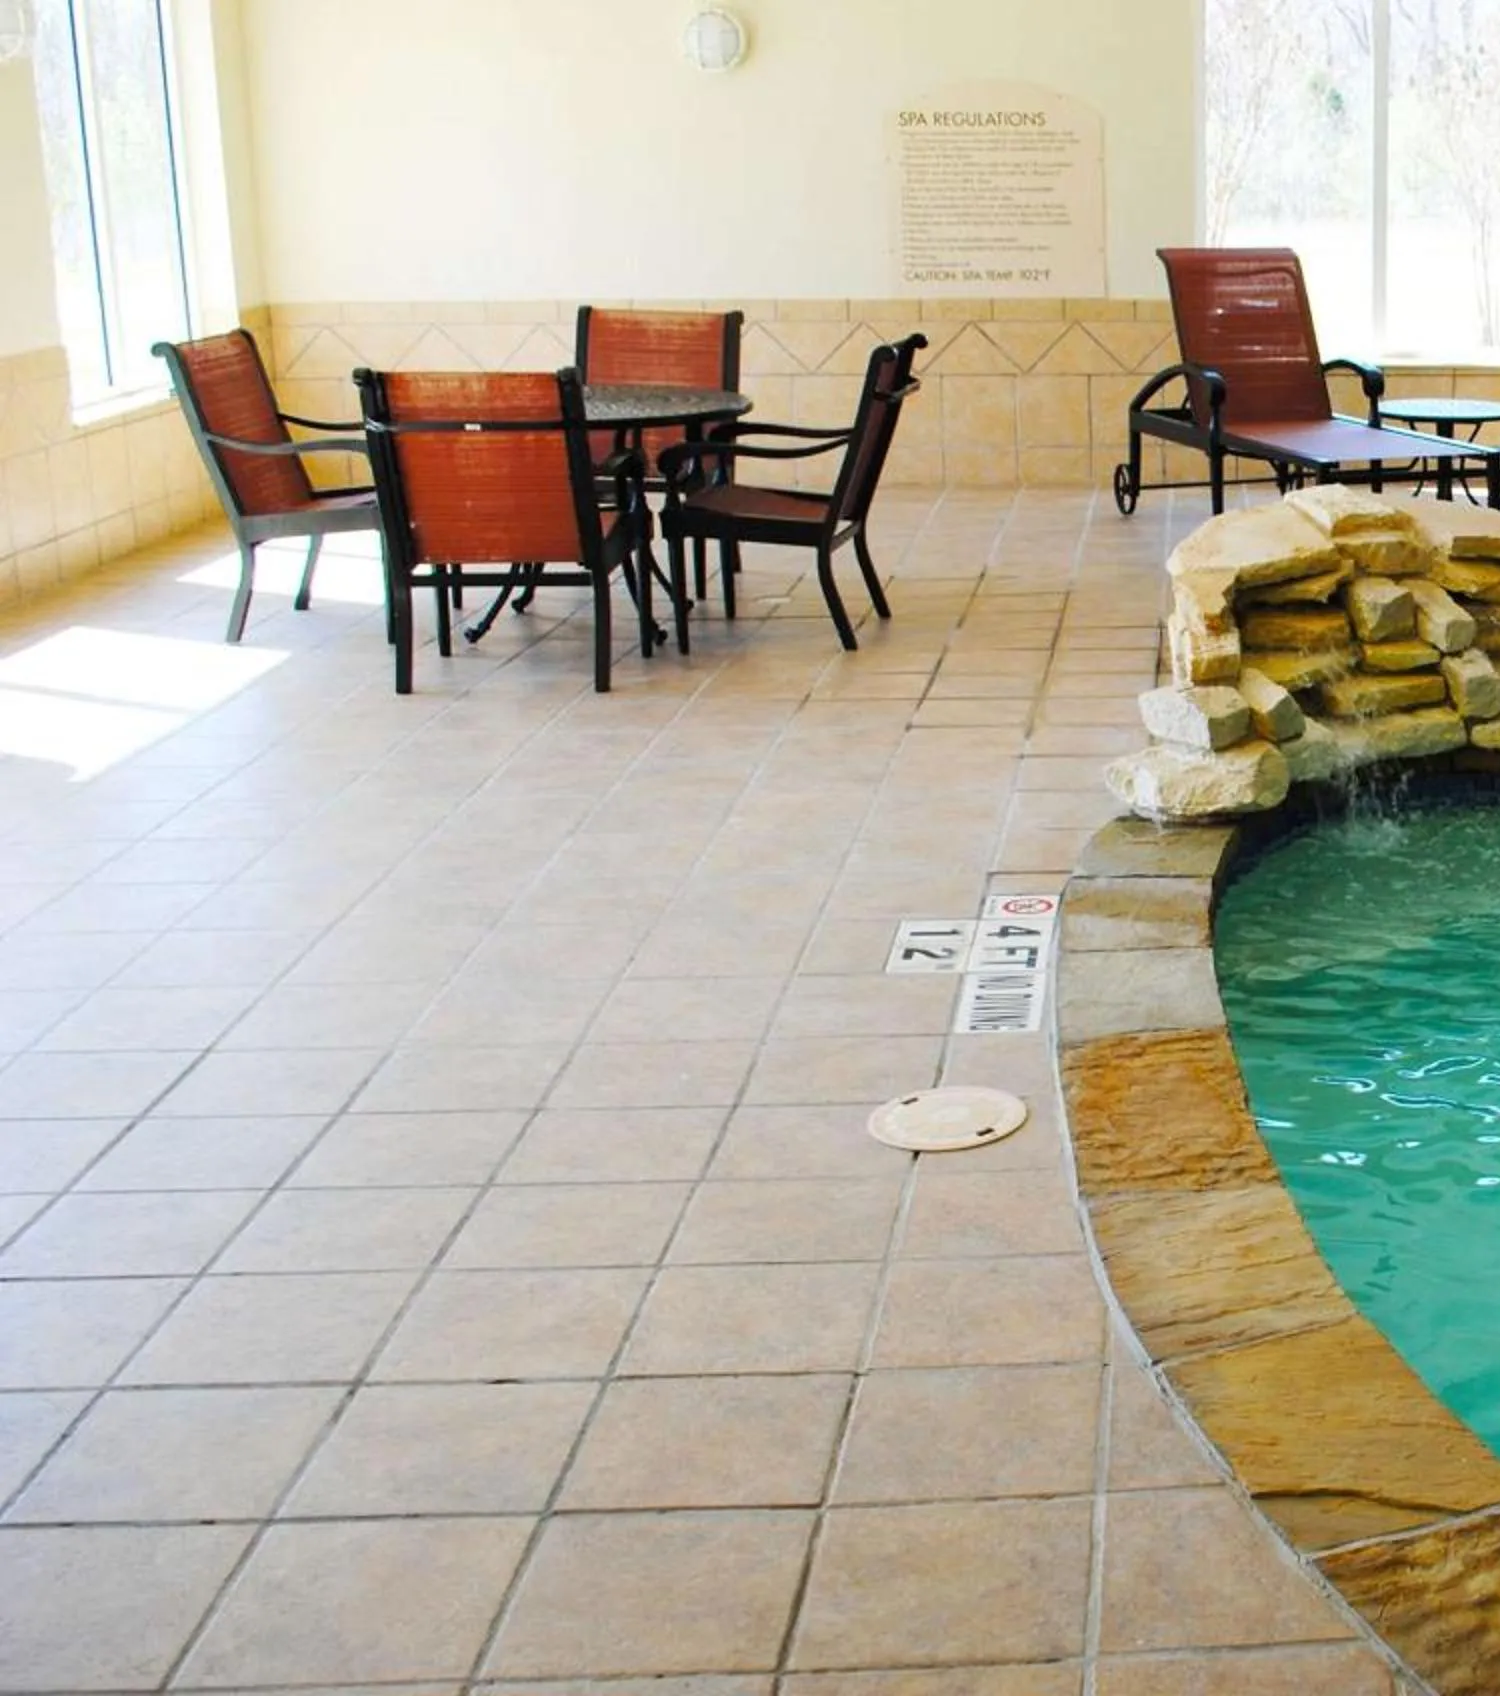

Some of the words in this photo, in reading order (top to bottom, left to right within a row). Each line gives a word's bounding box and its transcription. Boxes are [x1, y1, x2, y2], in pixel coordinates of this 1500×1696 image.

[899, 111, 928, 127] SPA
[933, 111, 1046, 127] REGULATIONS
[962, 270, 983, 282] SPA
[986, 926, 1041, 939] 4
[980, 946, 1039, 968] FT
[977, 975, 1035, 989] NO
[969, 994, 1033, 1030] DIVING
